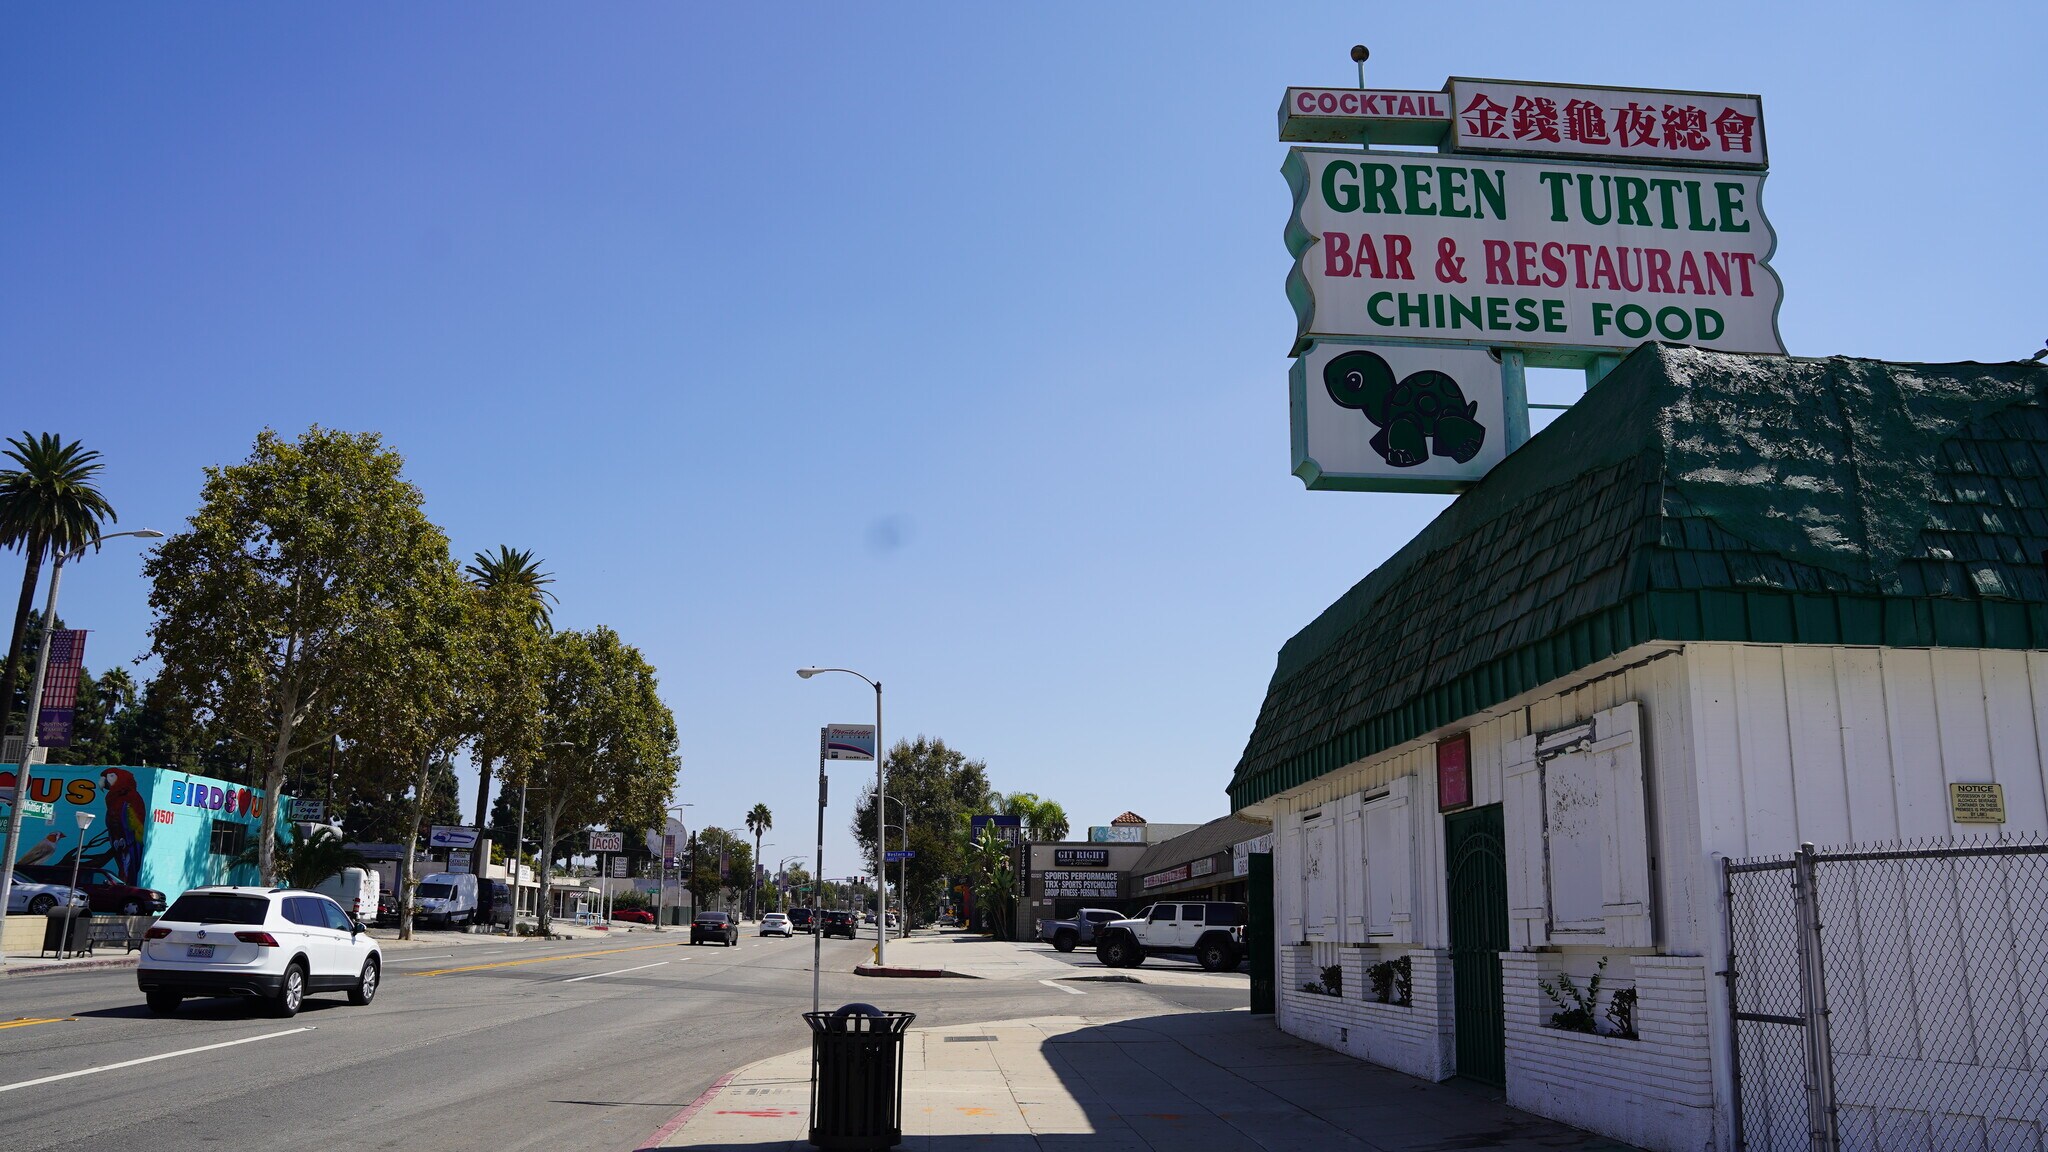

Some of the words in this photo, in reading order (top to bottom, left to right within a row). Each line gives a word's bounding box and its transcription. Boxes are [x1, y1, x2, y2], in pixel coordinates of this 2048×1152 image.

[1297, 92, 1445, 117] COCKTAIL
[1460, 93, 1757, 153] 金錢龜夜總會
[1321, 159, 1507, 221] GREEN
[1540, 171, 1751, 233] TURTLE
[1323, 231, 1416, 281] BAR
[1435, 237, 1467, 284] &
[1483, 239, 1756, 297] RESTAURANT
[1367, 291, 1568, 333] CHINESE
[1592, 303, 1725, 341] FOOD
[30, 778, 97, 805] US
[170, 779, 236, 814] BIRDS
[42, 803, 53, 814] Blvd
[153, 809, 175, 824] 11501
[591, 836, 620, 850] TACOS
[1058, 851, 1074, 859] GIT
[1076, 851, 1106, 859] RIGHT
[1044, 872, 1069, 880] SPORTS
[1070, 872, 1118, 880] PERFORMANCE
[1061, 881, 1082, 889] SPORTS
[1083, 881, 1118, 889] PSYCHOLOGY
[1045, 889, 1060, 897] GROUP
[1060, 889, 1078, 897] FITNESS
[1080, 889, 1100, 897] PERSONAL
[1100, 889, 1118, 897] TRAINING
